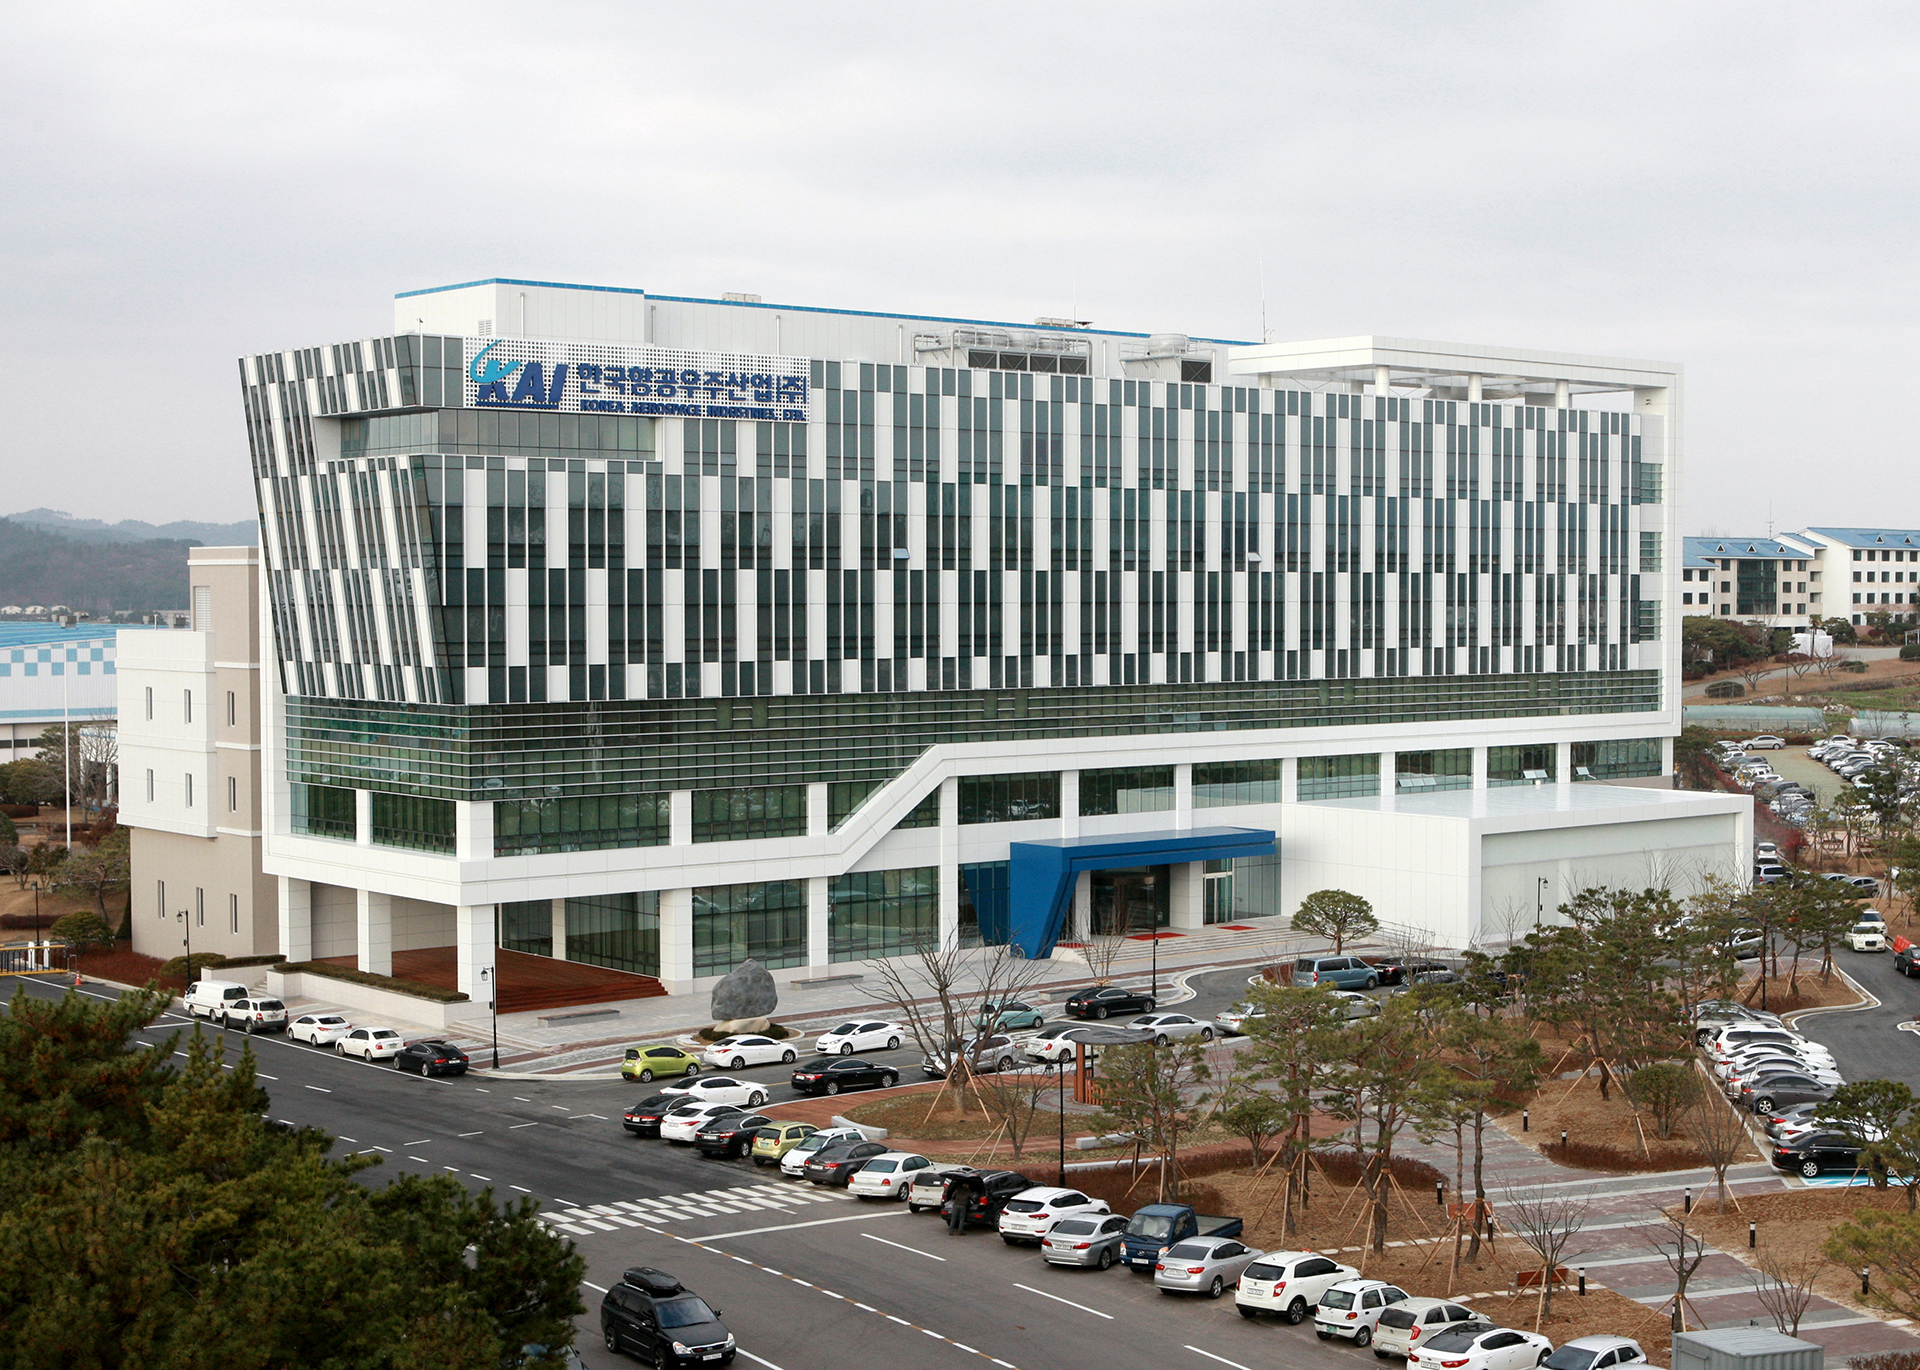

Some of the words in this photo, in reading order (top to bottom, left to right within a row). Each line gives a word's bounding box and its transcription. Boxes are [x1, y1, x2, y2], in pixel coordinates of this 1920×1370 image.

[470, 340, 568, 404] KAI
[580, 399, 625, 413] KOREA
[631, 402, 701, 417] AEROSPACE
